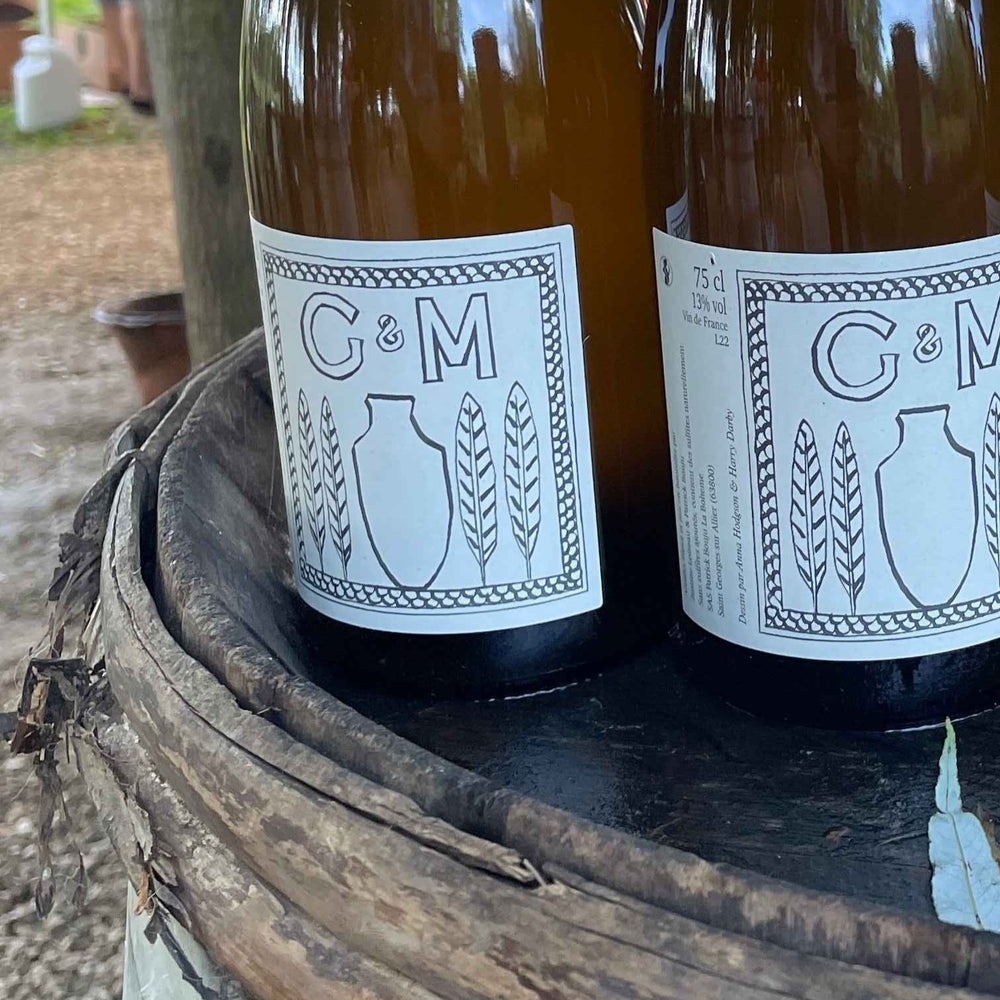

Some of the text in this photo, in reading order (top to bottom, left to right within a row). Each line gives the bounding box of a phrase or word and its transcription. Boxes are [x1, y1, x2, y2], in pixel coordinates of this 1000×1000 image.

[693, 266, 726, 293] 75 cl
[691, 292, 727, 315] 13% vol
[681, 309, 729, 332] Vin de France
[707, 464, 718, 504] (63800)
[710, 506, 719, 534] Allier
[724, 408, 747, 625] Dessin par Anna Hodgson & Harry Darby
[714, 553, 723, 591] Georges
[717, 593, 725, 618] Saint
